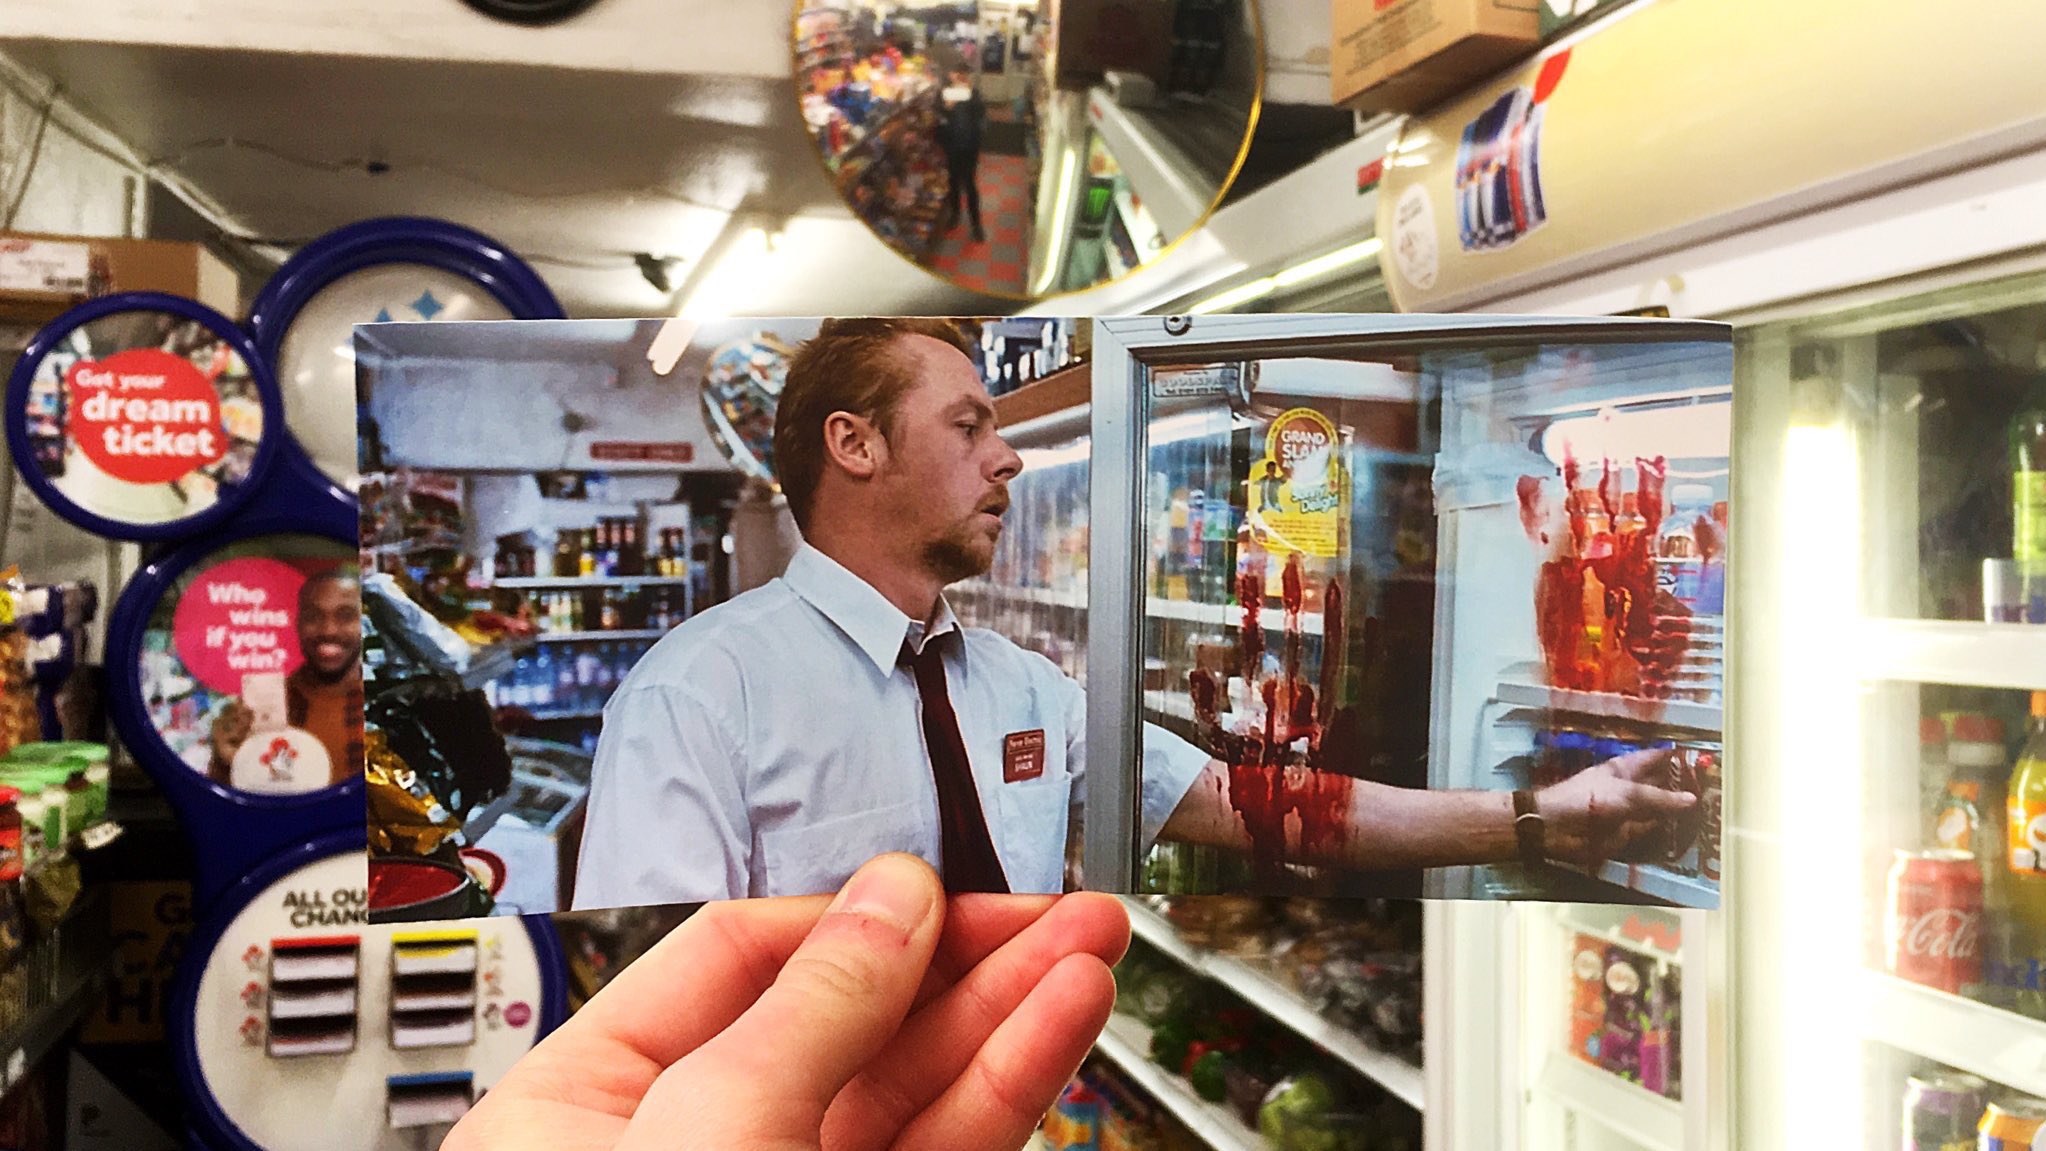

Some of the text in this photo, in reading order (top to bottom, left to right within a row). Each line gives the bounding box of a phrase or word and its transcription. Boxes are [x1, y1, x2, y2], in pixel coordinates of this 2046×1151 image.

[75, 368, 166, 393] Get your
[81, 390, 212, 423] dream
[102, 423, 217, 458] ticket
[1281, 429, 1326, 445] GRAND
[207, 582, 268, 605] Who
[228, 606, 289, 628] wins
[206, 626, 277, 656] if you
[227, 648, 287, 671] win?
[282, 887, 368, 908] ALL OU
[289, 908, 368, 929] CHAN
[1906, 907, 1979, 958] Cola
